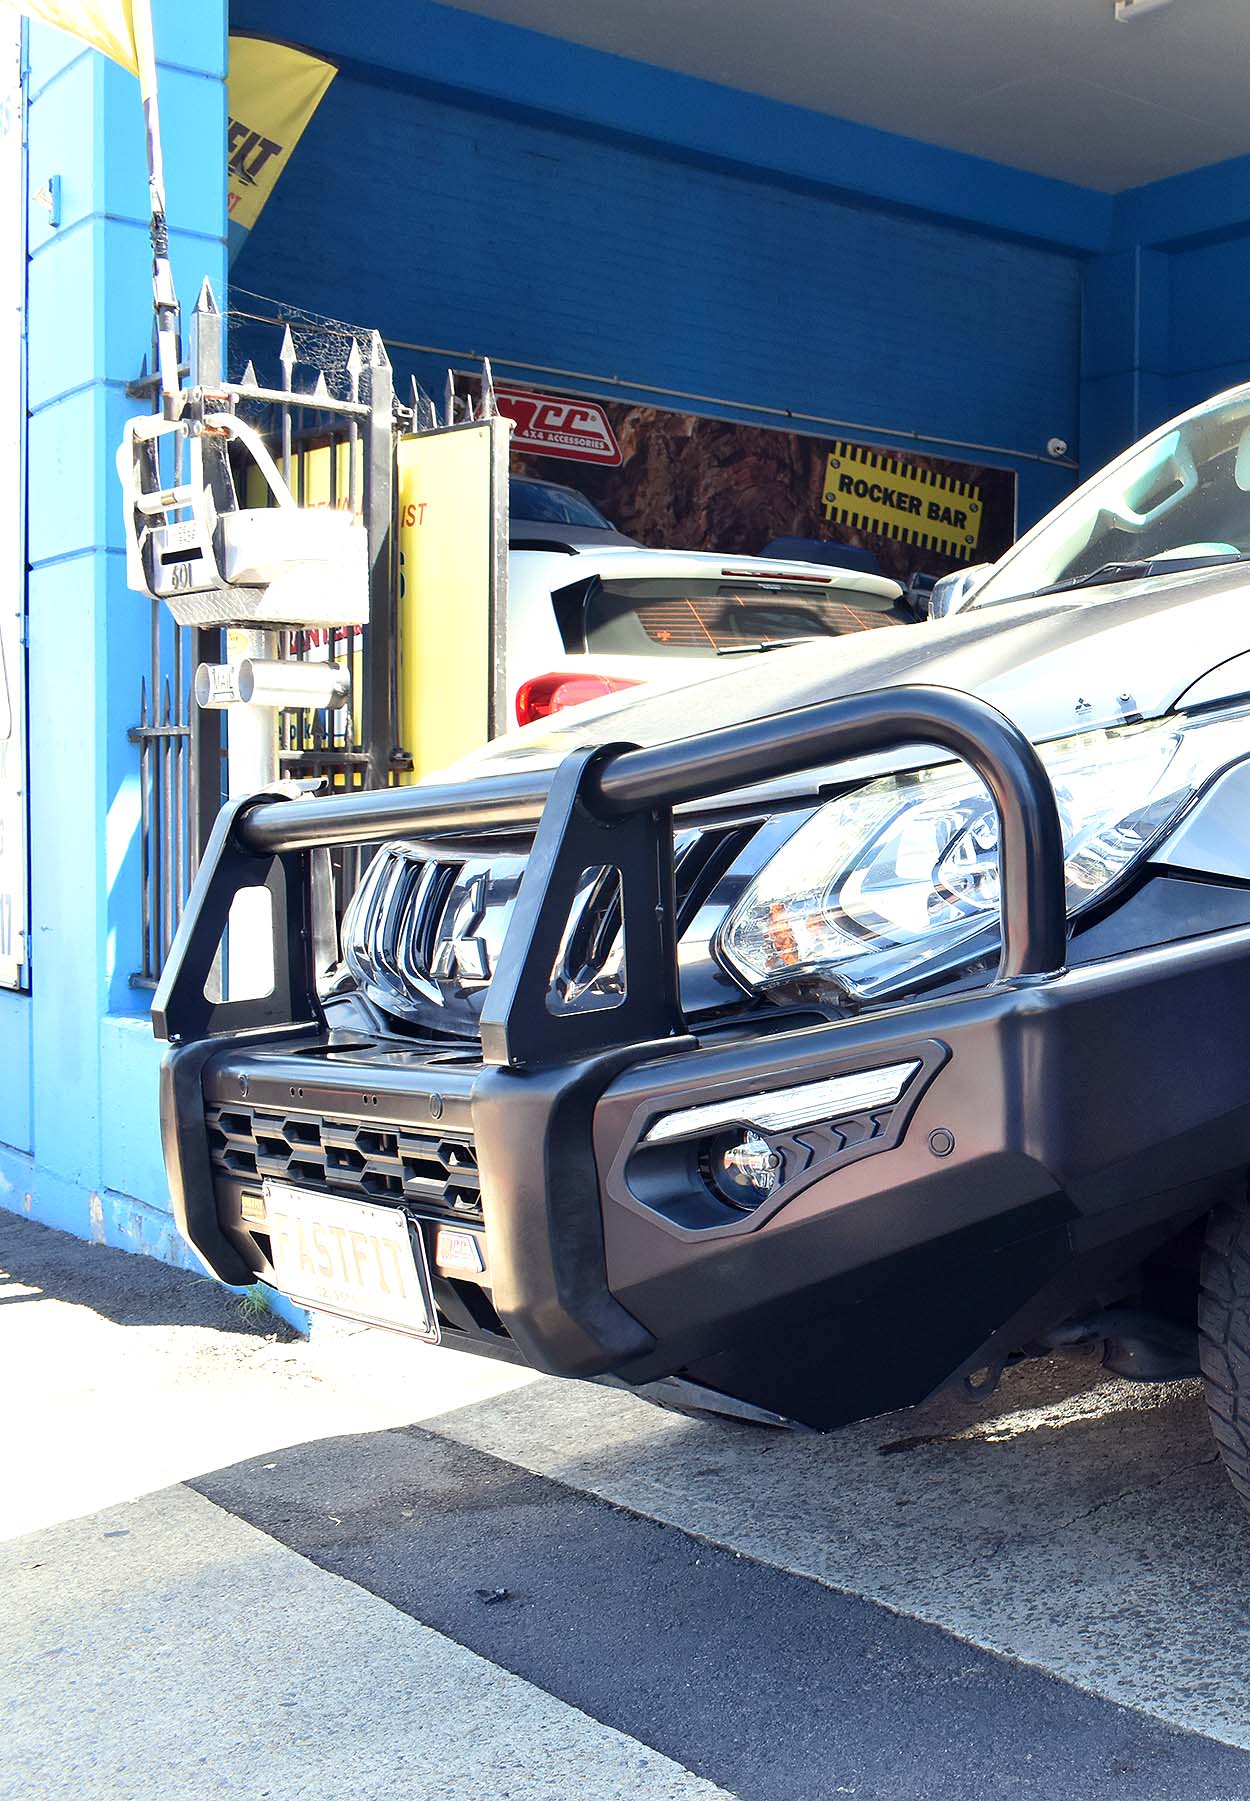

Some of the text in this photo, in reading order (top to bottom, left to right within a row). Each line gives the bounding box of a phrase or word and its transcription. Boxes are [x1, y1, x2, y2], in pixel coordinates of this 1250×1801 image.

[523, 429, 605, 449] 4X4 ACCESSORIES
[838, 473, 968, 530] ROCKER BAR
[274, 1212, 407, 1299] FASTFIT
